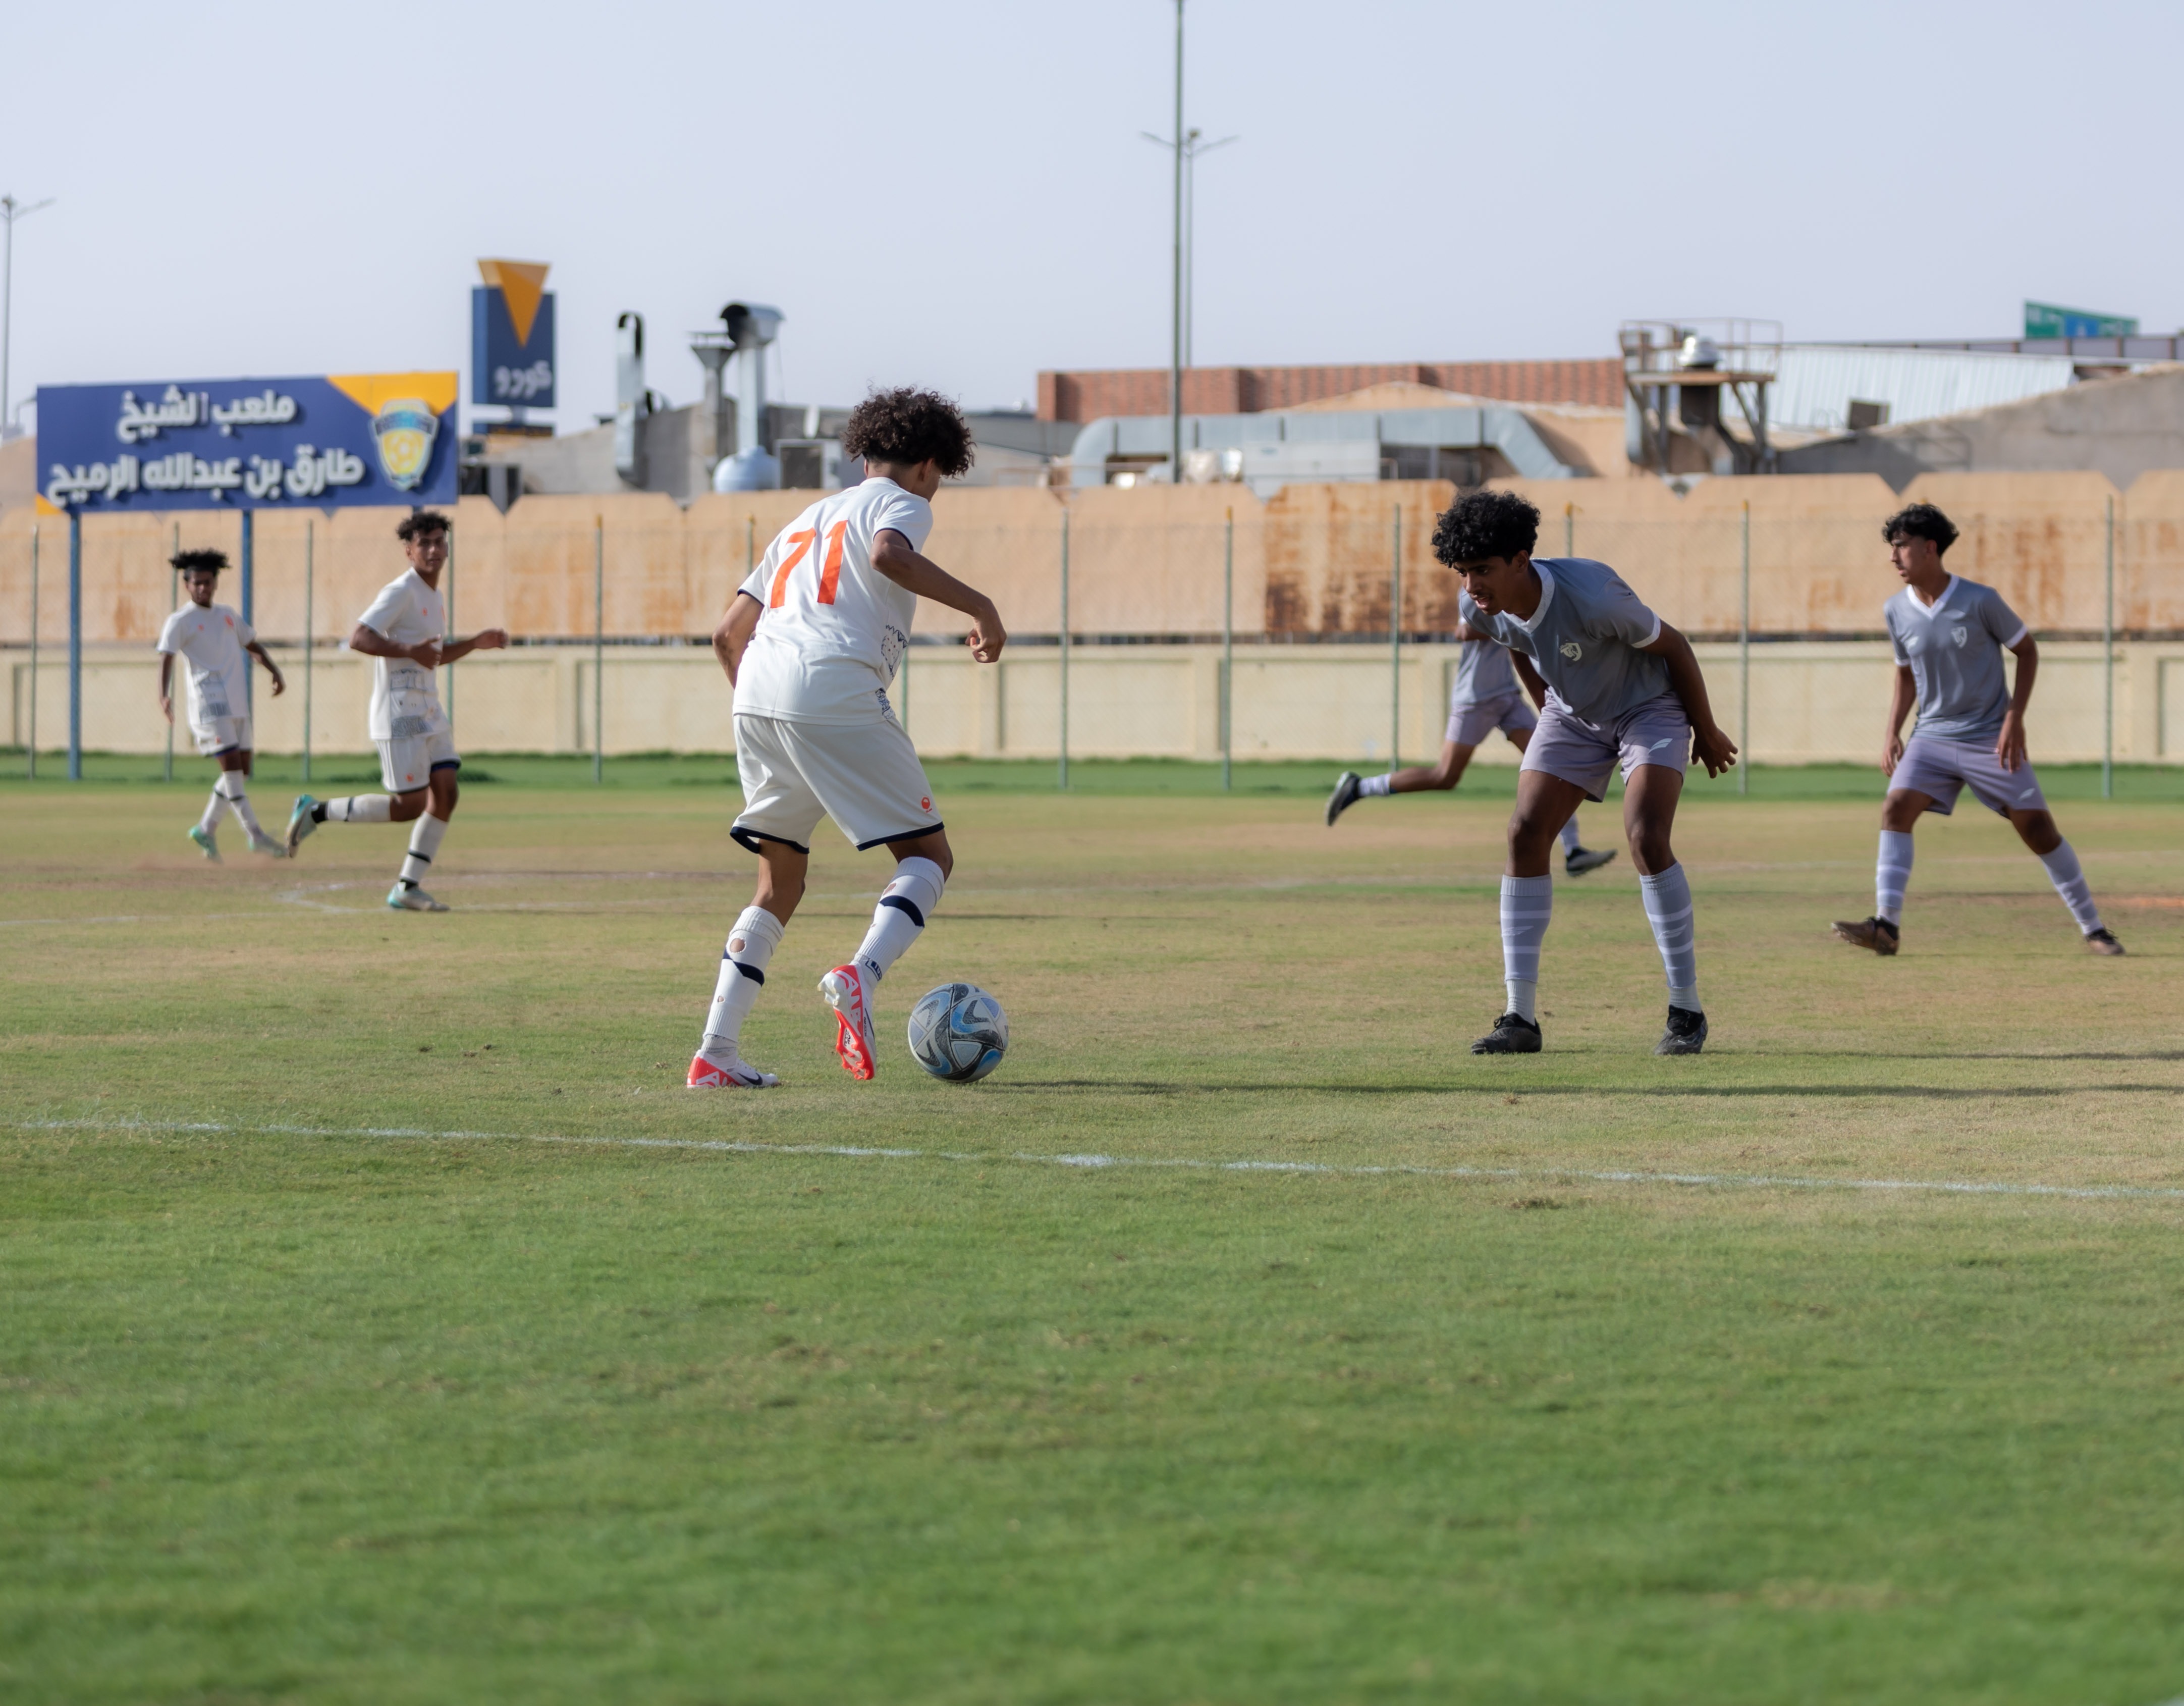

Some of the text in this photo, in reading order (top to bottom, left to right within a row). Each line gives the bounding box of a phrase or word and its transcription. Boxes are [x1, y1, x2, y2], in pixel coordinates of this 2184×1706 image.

[116, 384, 297, 444] ملعب الشيخ
[46, 444, 365, 508] طارق بن عبدالله الرميح
[770, 520, 848, 609] 71
